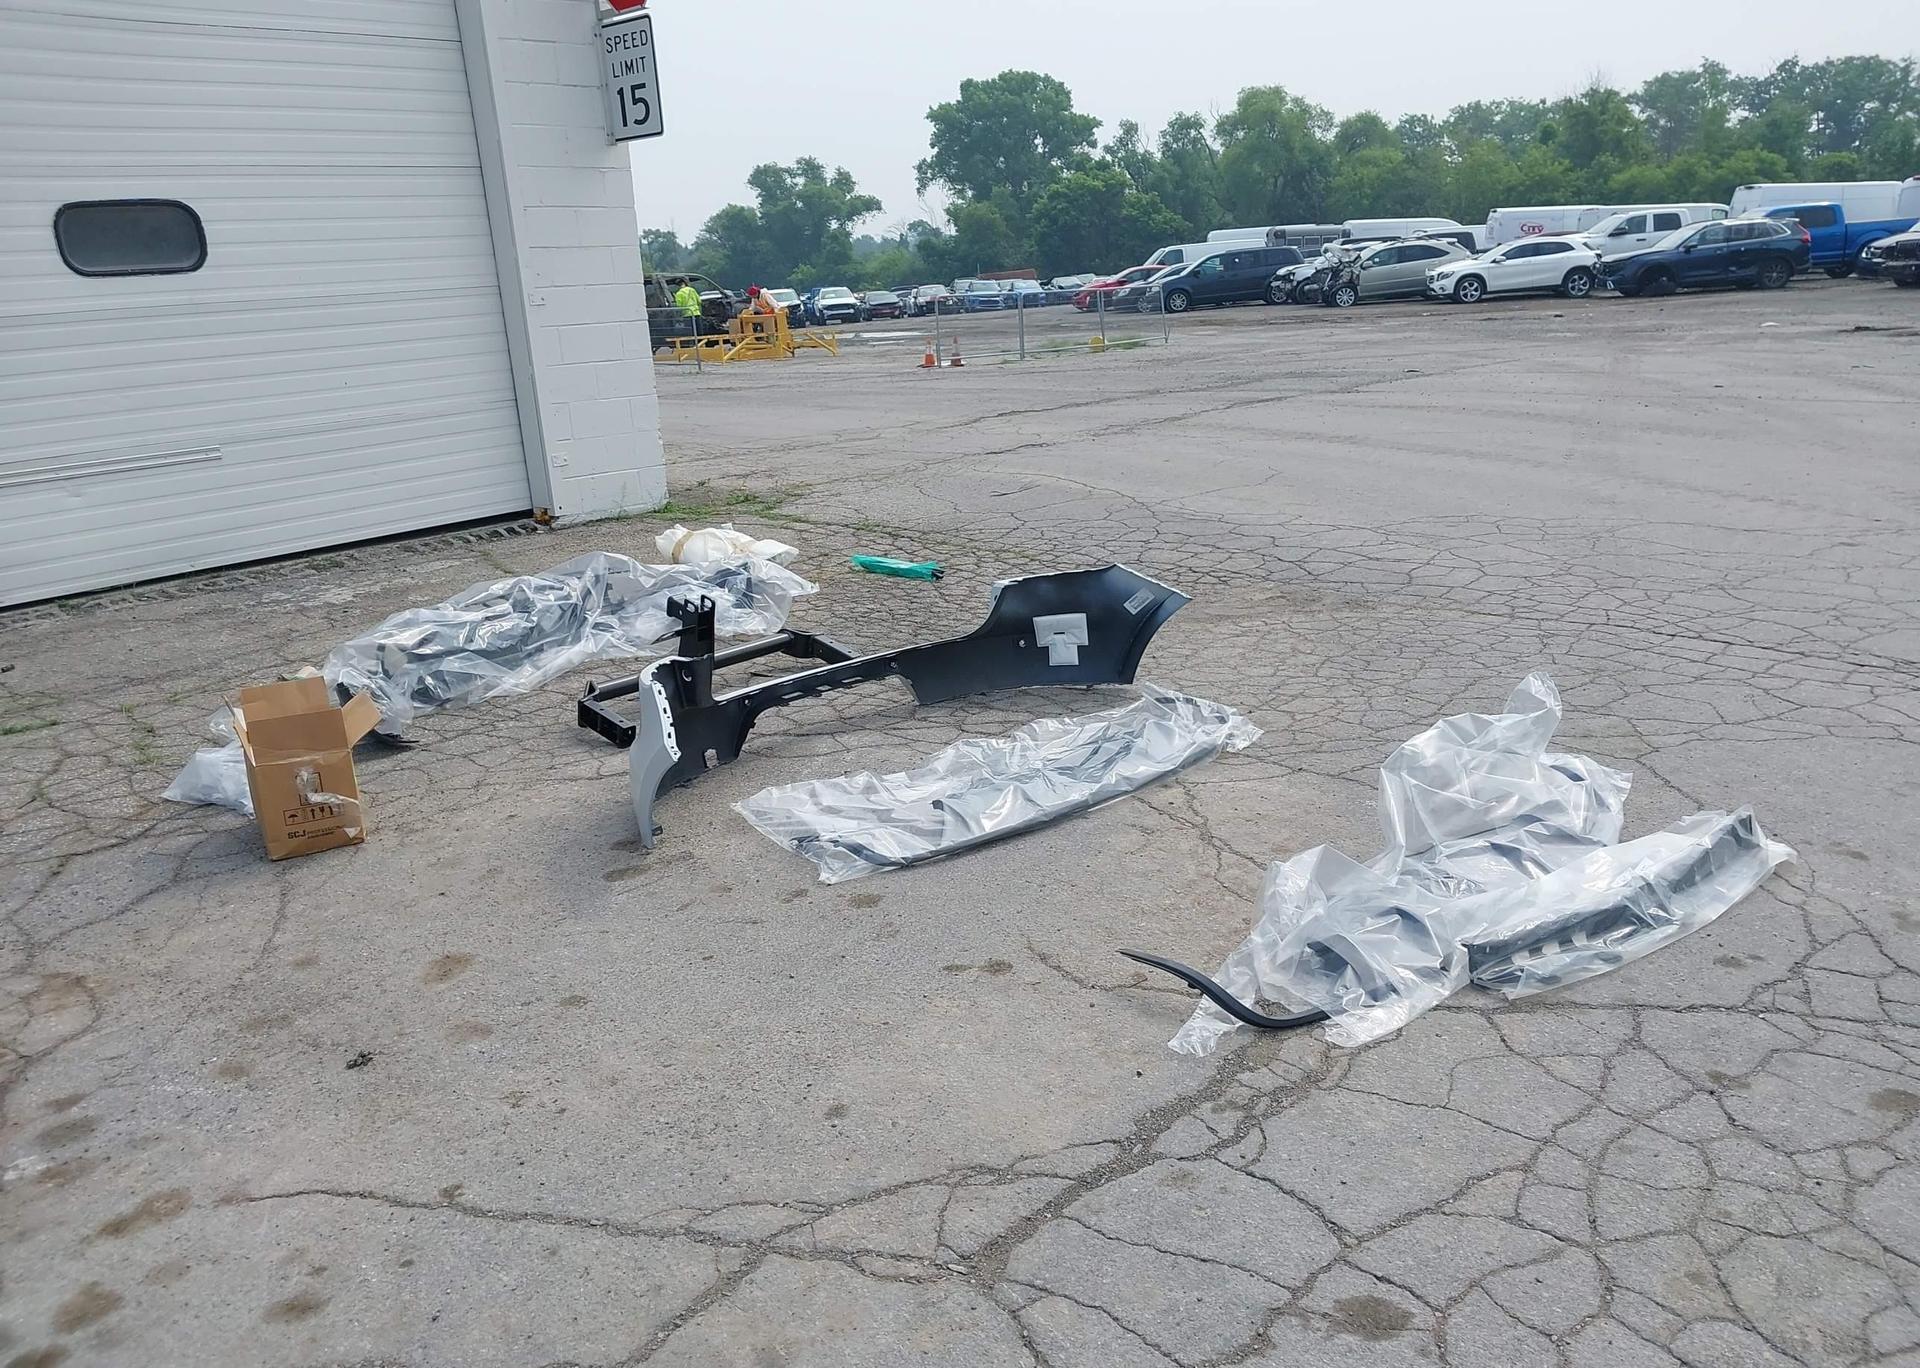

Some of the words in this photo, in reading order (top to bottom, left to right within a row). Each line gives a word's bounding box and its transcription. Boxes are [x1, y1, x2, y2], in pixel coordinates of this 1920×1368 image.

[605, 29, 649, 54] SPEED
[611, 56, 647, 79] LIMIT
[616, 82, 651, 128] 15
